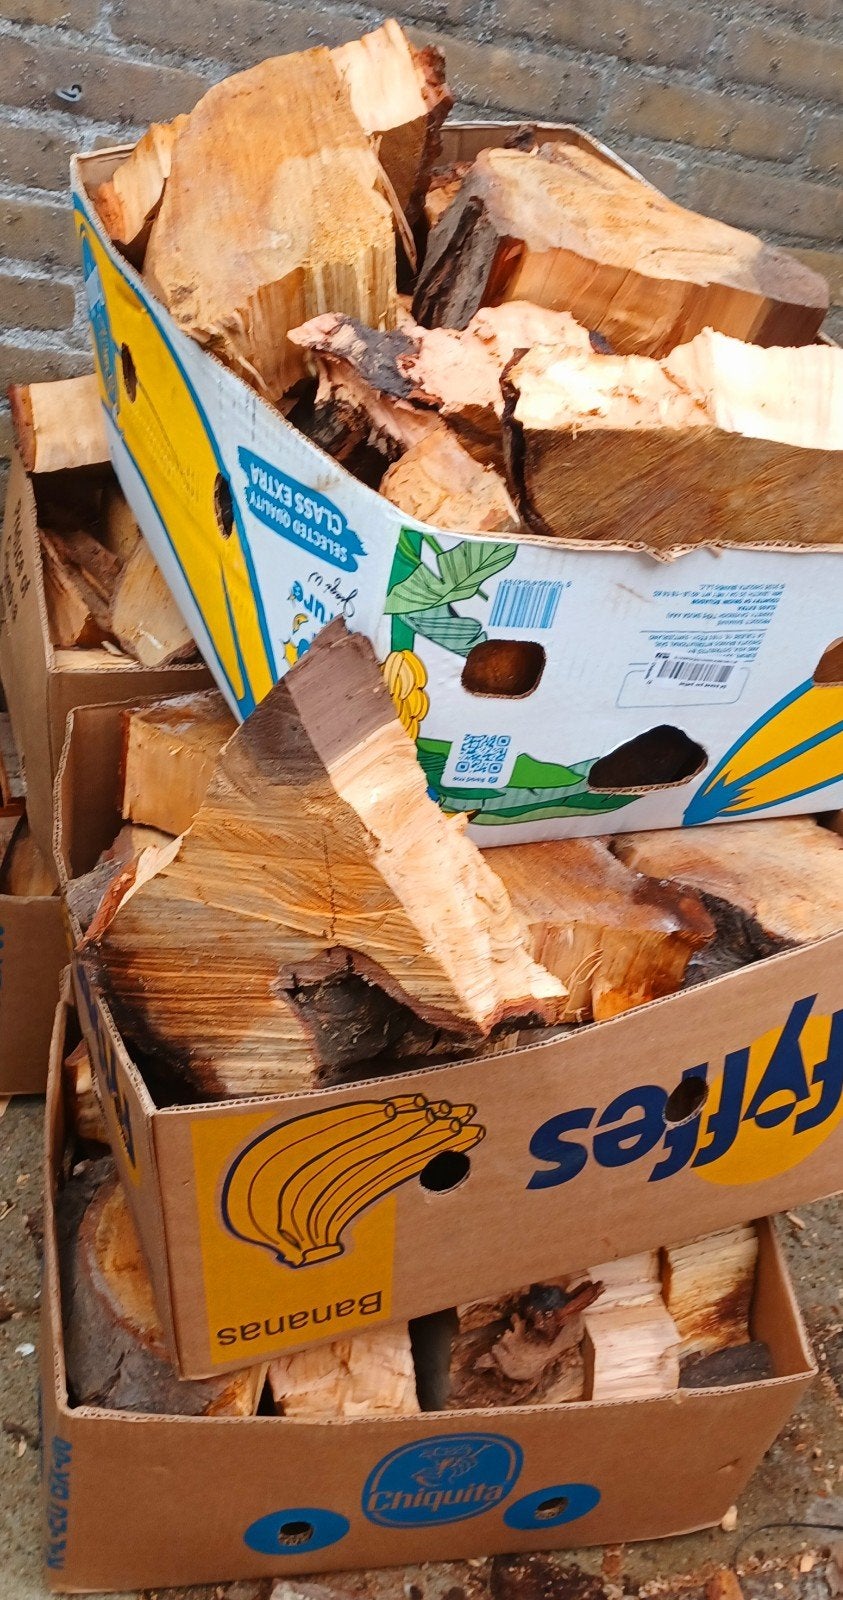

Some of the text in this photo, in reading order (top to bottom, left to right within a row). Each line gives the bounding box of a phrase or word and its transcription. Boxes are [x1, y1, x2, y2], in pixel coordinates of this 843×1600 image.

[249, 490, 348, 562] SELECTED QUALITY
[250, 463, 342, 536] CLASS EXTRA
[216, 1290, 383, 1346] Bananas
[366, 1483, 504, 1513] Chiquita
